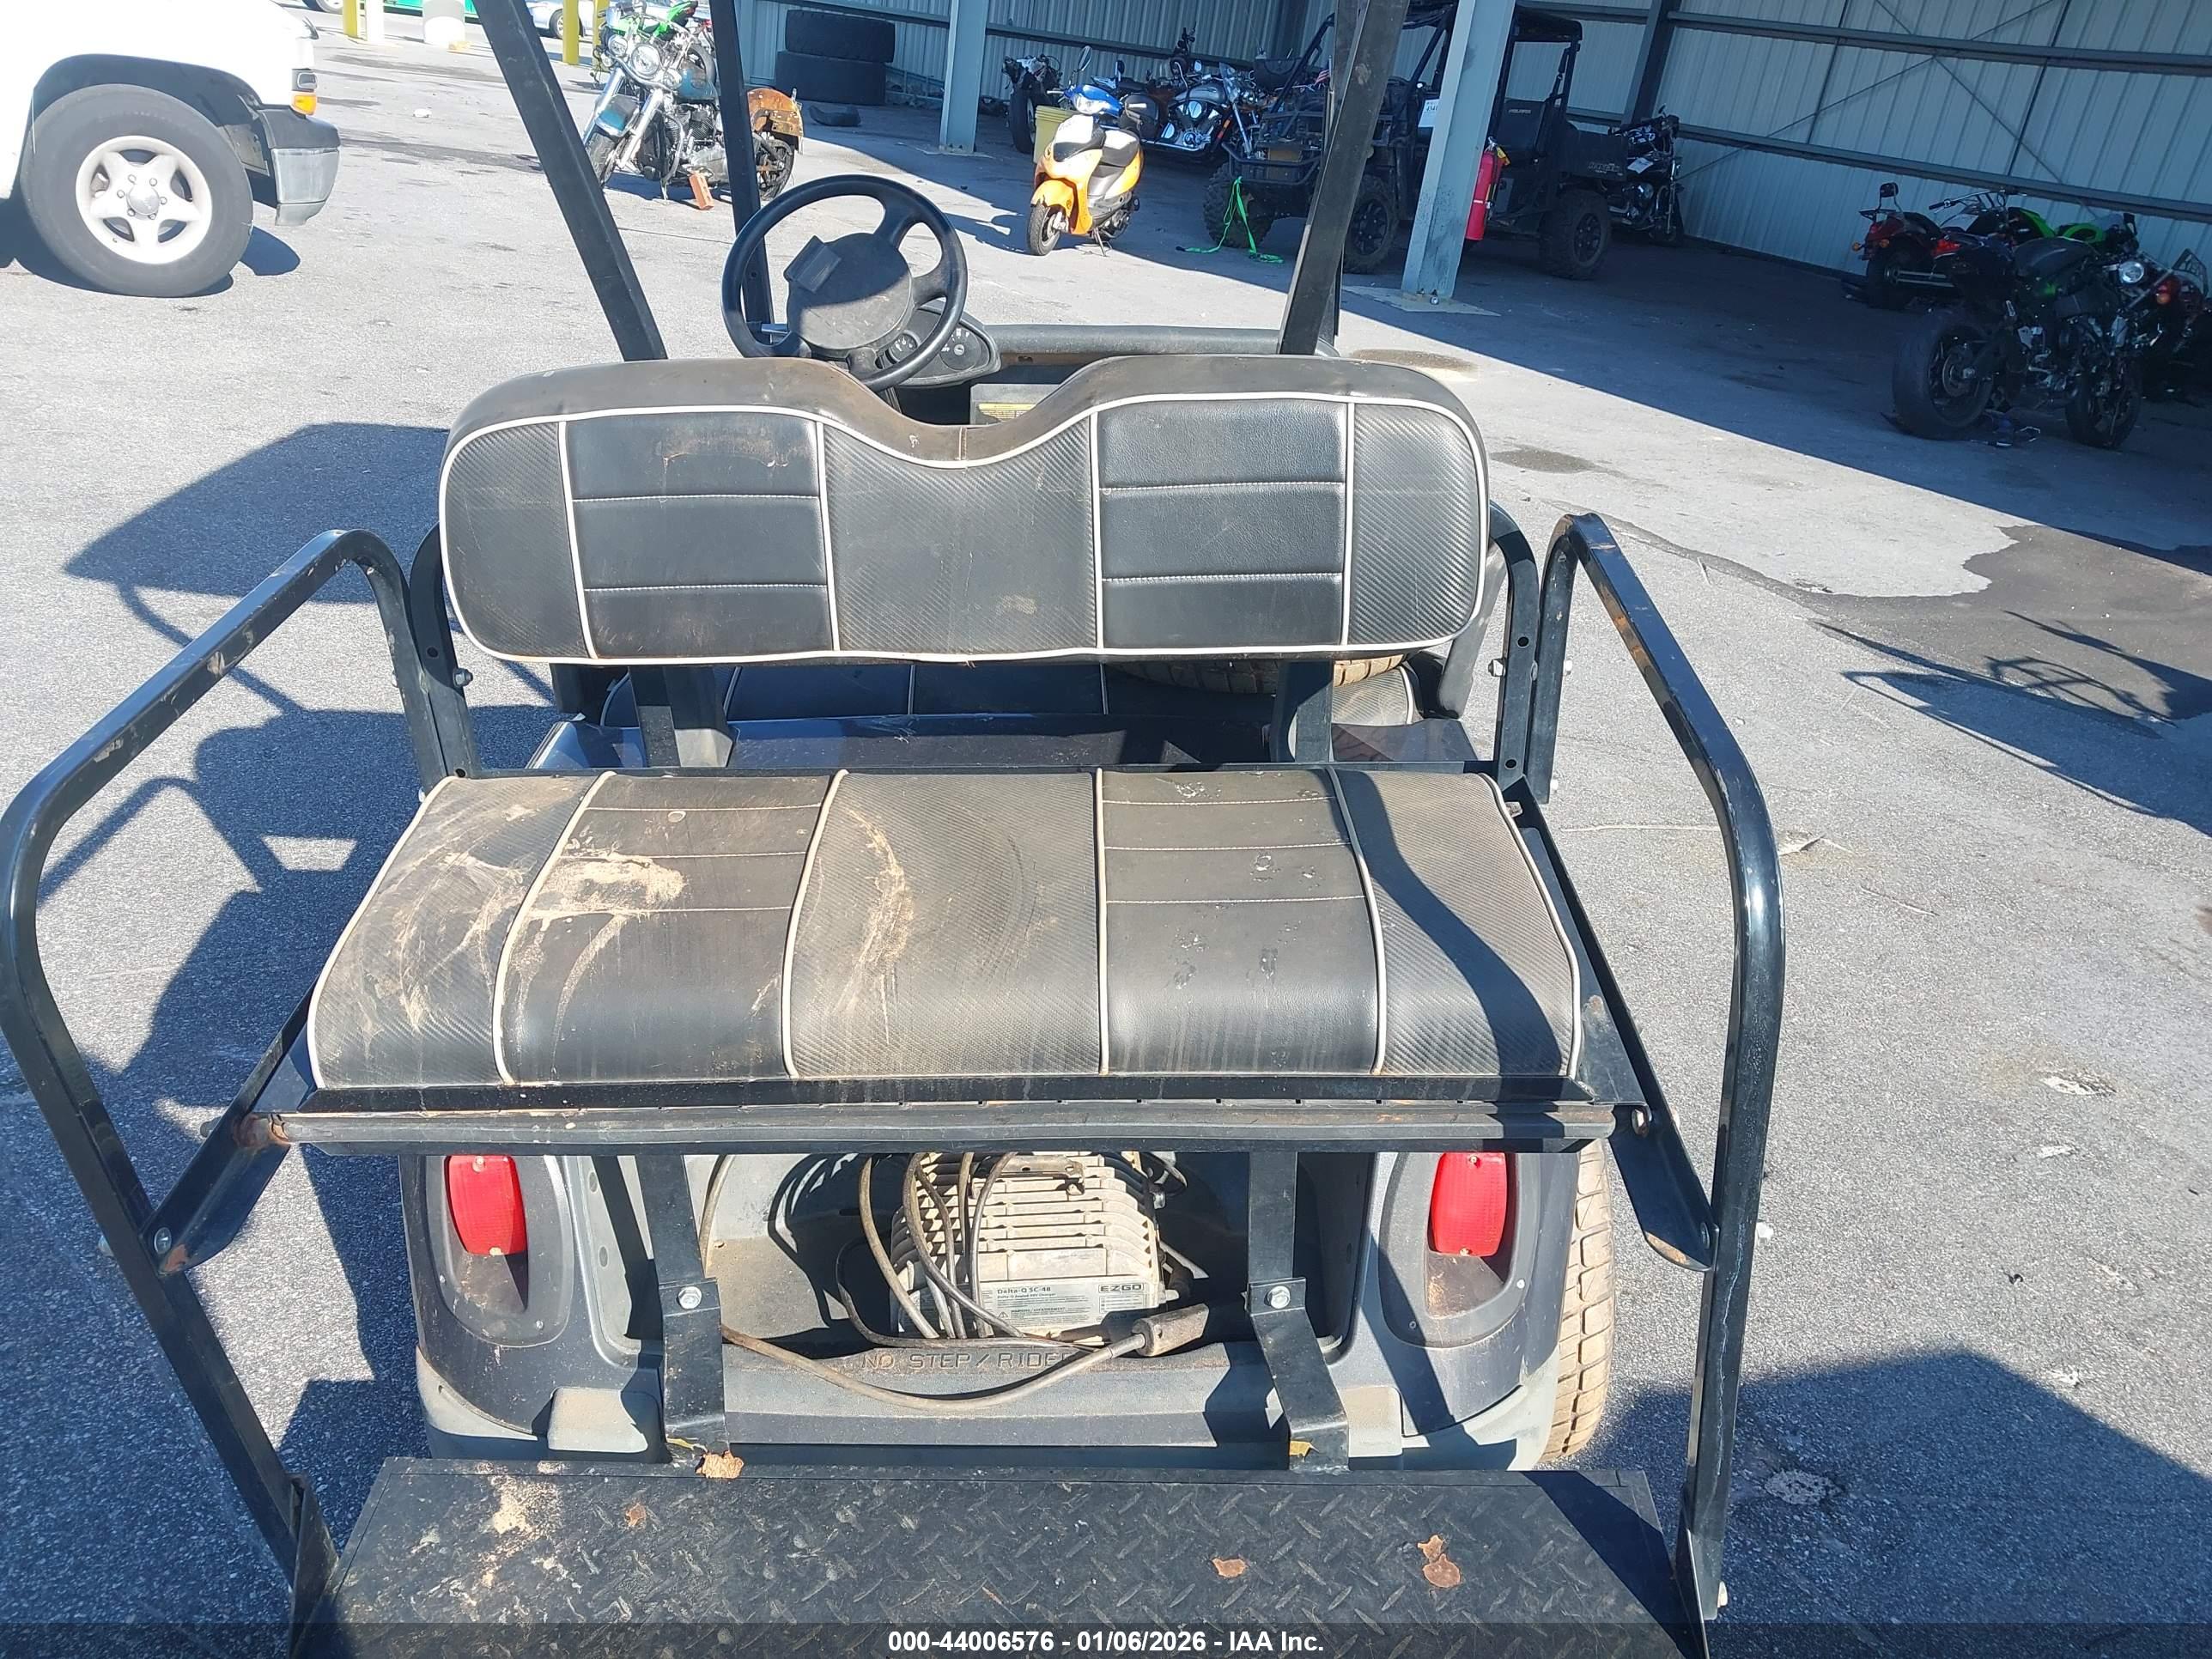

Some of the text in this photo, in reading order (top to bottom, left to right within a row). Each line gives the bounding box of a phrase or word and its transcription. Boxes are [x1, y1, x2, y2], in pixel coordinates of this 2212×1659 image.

[1100, 1284, 1142, 1292] EZGO
[861, 1353, 896, 1370] NO
[908, 1352, 971, 1369] STEP
